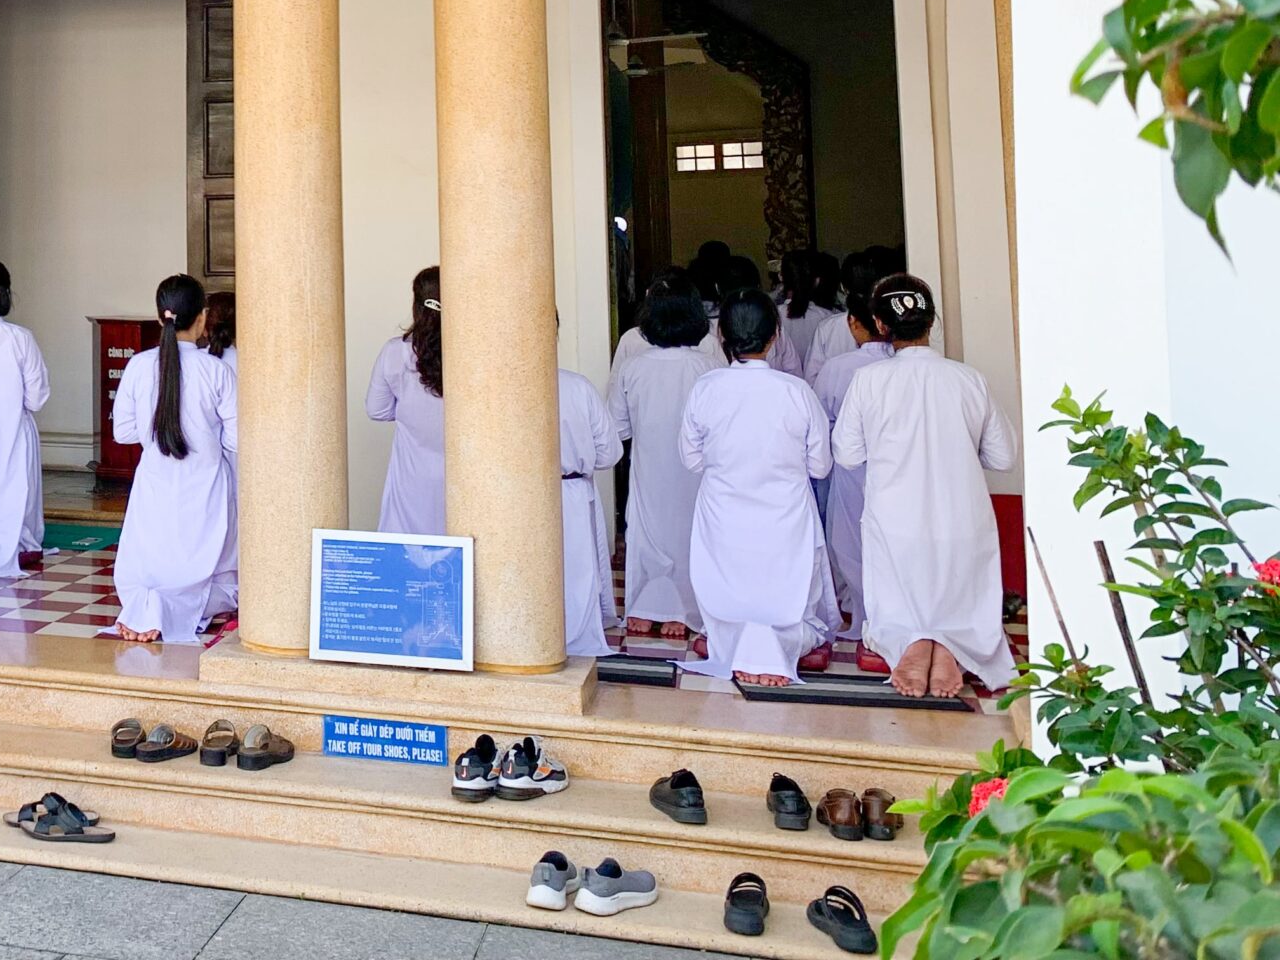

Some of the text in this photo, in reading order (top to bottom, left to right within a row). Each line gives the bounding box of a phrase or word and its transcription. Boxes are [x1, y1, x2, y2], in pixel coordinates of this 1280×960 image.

[335, 722, 348, 735] XIN
[328, 739, 443, 763] TAKE OFF YOUR SHOES, PLEASE!
